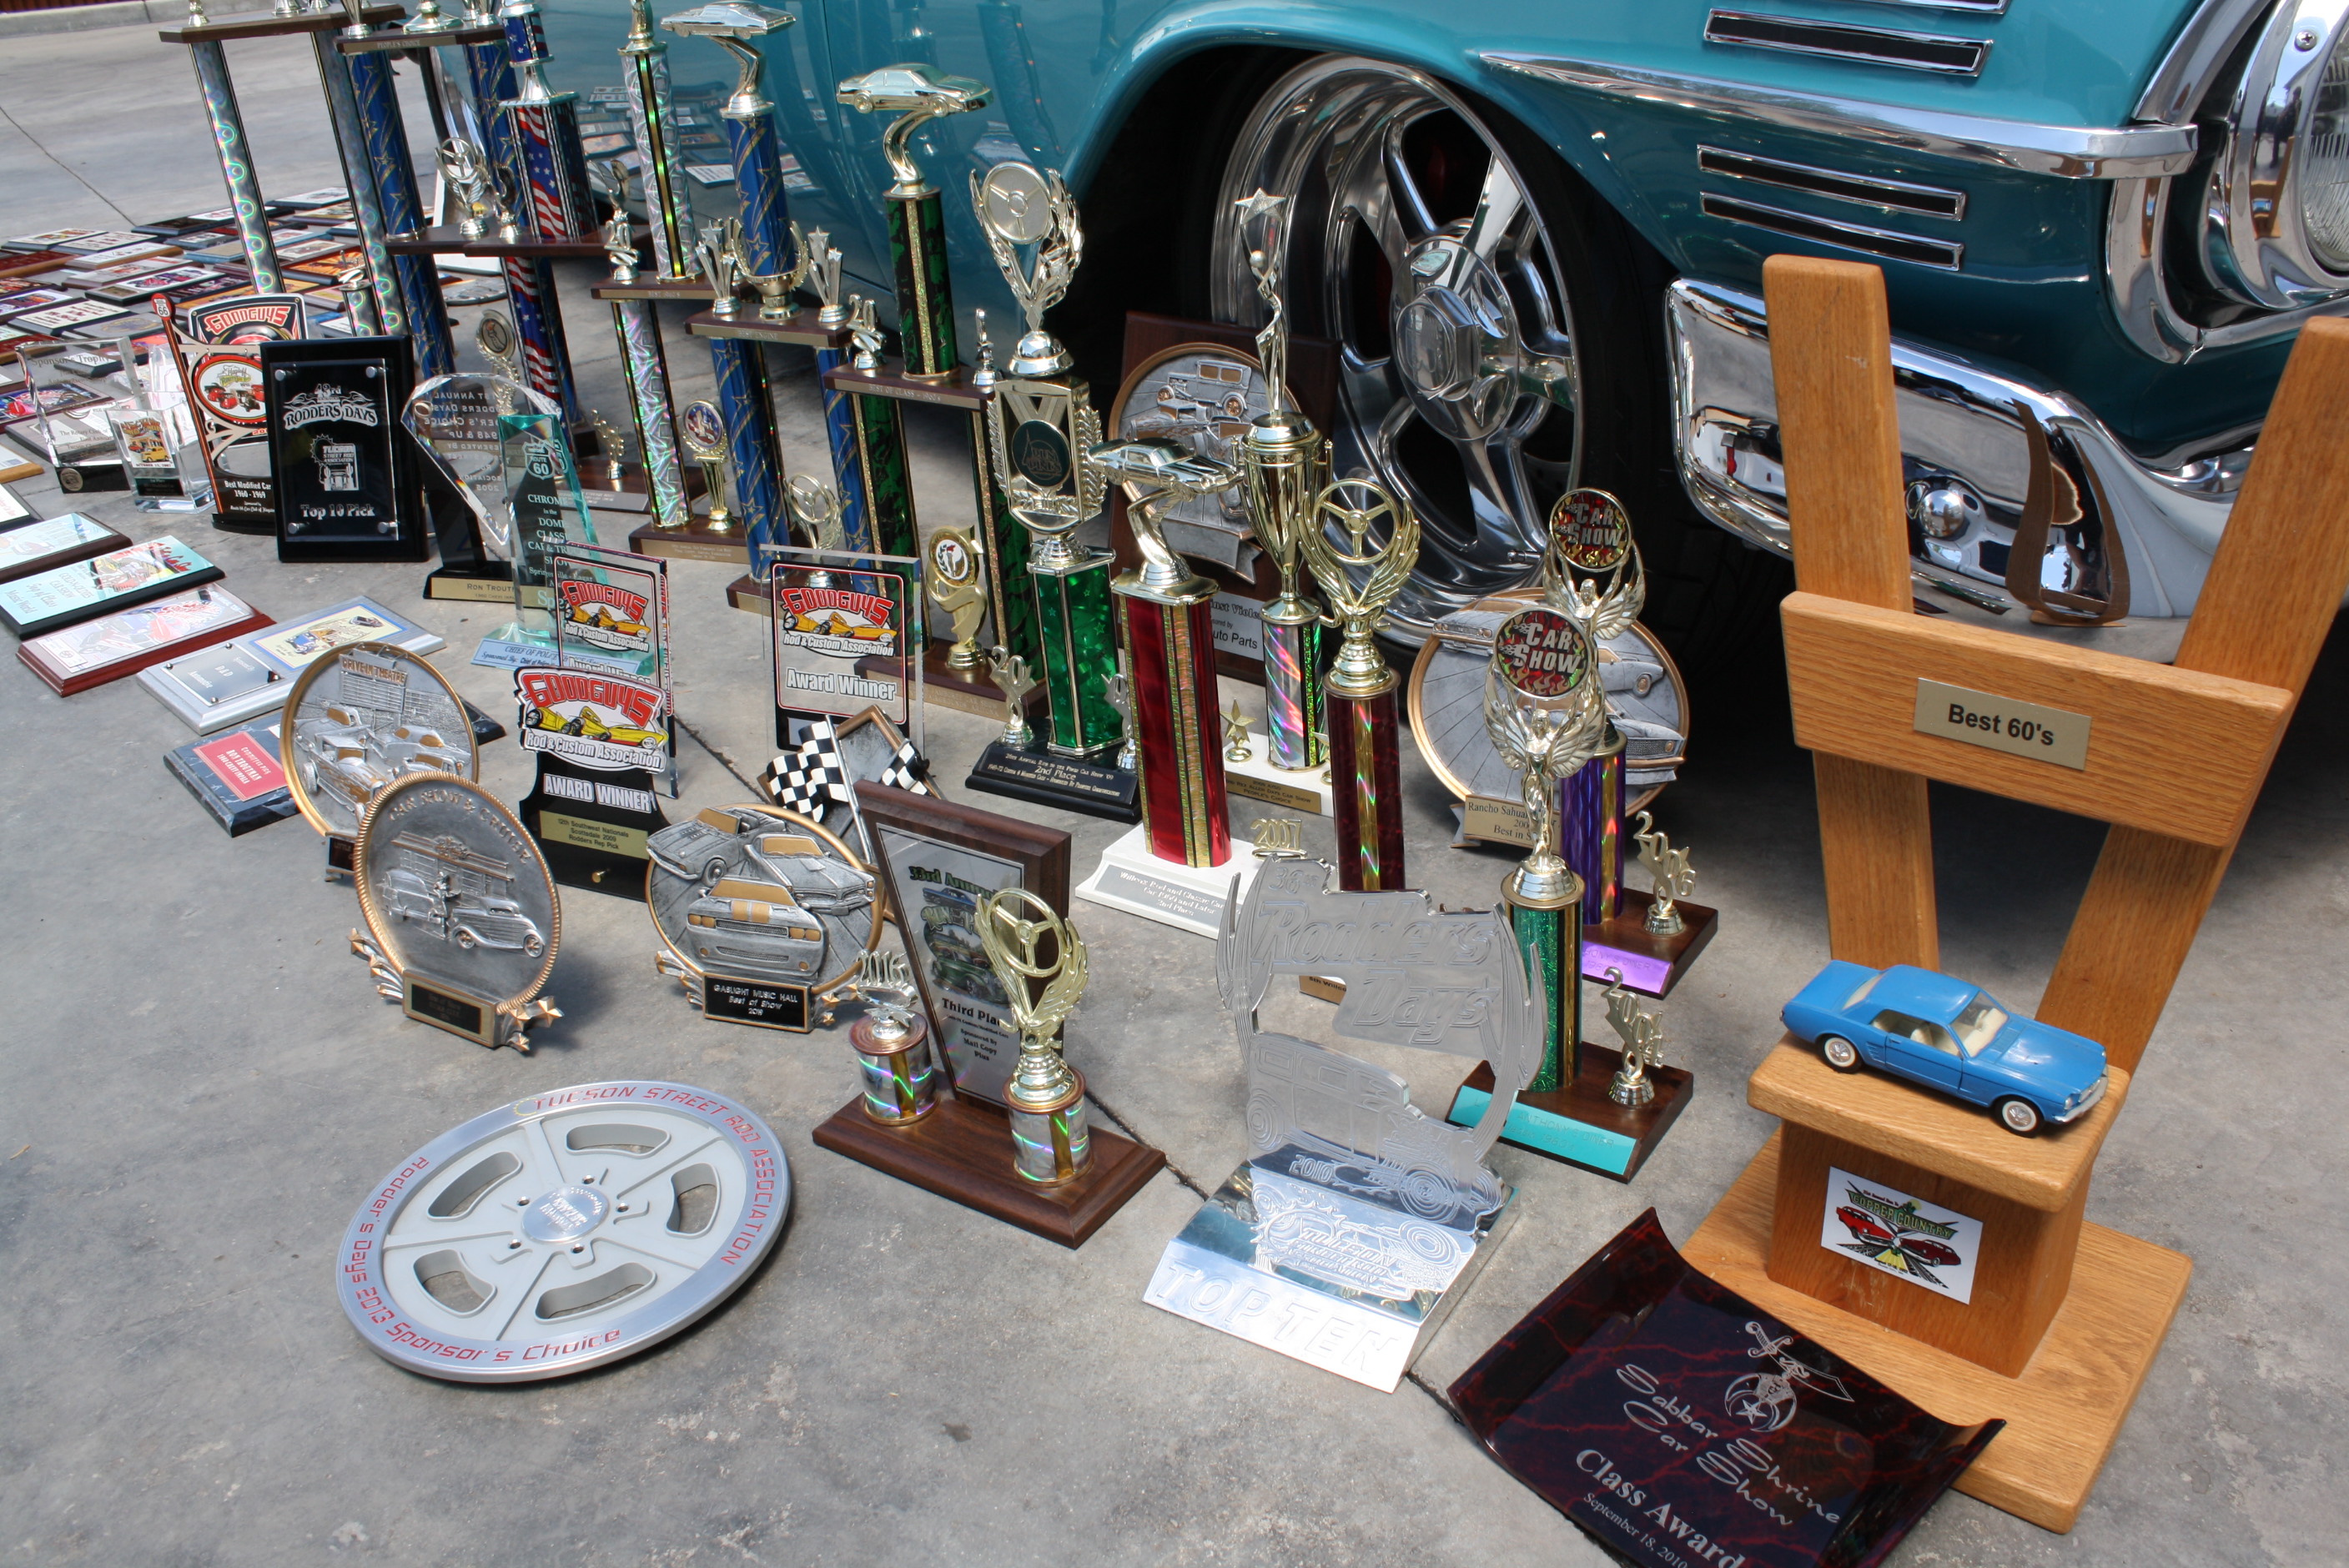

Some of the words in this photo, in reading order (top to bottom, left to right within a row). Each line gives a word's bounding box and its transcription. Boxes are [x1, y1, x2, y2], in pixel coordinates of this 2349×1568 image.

[204, 306, 291, 335] GOODGUYS
[314, 383, 342, 398] 43rd
[284, 404, 343, 430] RODDERS
[342, 405, 378, 426] DAYS
[533, 463, 549, 475] 60
[237, 480, 261, 489] Modified
[300, 504, 326, 520] Top
[329, 504, 345, 516] 10
[346, 504, 375, 517] Pick
[1576, 503, 1614, 527] CAR
[1567, 523, 1623, 547] SHOW
[467, 583, 483, 591] RON
[561, 580, 649, 624] GOODGUYS
[781, 588, 894, 627] GOODGUYS
[505, 645, 525, 655] CHIEF
[565, 625, 578, 635] Rod
[583, 629, 609, 644] Custom
[610, 634, 650, 652] Association
[783, 633, 801, 646] Rod
[807, 637, 841, 650] Custom
[842, 641, 894, 656] Association
[1212, 629, 1229, 642] uto
[1231, 633, 1258, 650] Parts
[1527, 622, 1572, 652] CAR
[1514, 642, 1581, 674] SHOW
[374, 666, 406, 683] THEATRE
[787, 668, 835, 693] Award
[838, 676, 897, 700] Winner
[522, 674, 659, 728] GOODGUYS
[1949, 703, 2000, 733] Best
[2008, 718, 2054, 746] 60's
[526, 732, 547, 750] Rod
[547, 739, 556, 750] &
[556, 736, 595, 758] Custom
[597, 745, 661, 768] Association
[1034, 766, 1051, 775] 2nd
[1054, 771, 1076, 781] Place
[390, 797, 415, 822] CAR
[421, 788, 464, 806] SHOW
[545, 774, 594, 802] AWARD
[596, 783, 651, 813] WINNER
[1468, 802, 1499, 815] Rancho
[569, 834, 593, 845] Rodders
[594, 839, 605, 848] Rep
[606, 841, 619, 850] Pick
[571, 820, 601, 832] Southwest
[602, 827, 629, 837] Nationals
[571, 827, 601, 839] Scottsdale
[1251, 820, 1302, 852] 2007
[1494, 824, 1512, 835] Best
[1515, 829, 1524, 839] in
[908, 866, 943, 884] 33rd
[1251, 899, 1501, 966] Rodders
[713, 984, 749, 997] GASLIGHT
[752, 988, 777, 999] MUSIC
[779, 992, 797, 1003] HALL
[728, 995, 746, 1004] Best
[749, 999, 758, 1008] of
[761, 1000, 782, 1009] Show
[1352, 968, 1501, 1045] Days
[942, 998, 973, 1017] Third
[978, 1009, 999, 1027] Pla
[960, 1028, 988, 1043] Sponsored
[980, 1043, 997, 1055] Copy
[974, 1050, 989, 1061] Plus
[534, 1085, 638, 1111] TUCSON
[642, 1086, 729, 1116] STREET
[722, 1114, 762, 1144] ROD
[1289, 1154, 1335, 1182] 2010
[361, 1156, 430, 1234] Rodder's
[720, 1148, 776, 1267] ASSOCIATION
[1853, 1194, 1894, 1222] COPPER
[1897, 1212, 1950, 1239] COUNTRY
[344, 1239, 372, 1284] Days
[355, 1286, 396, 1325] 2013
[1156, 1262, 1272, 1324] TOP
[1275, 1303, 1399, 1374] TEN
[385, 1321, 515, 1363] Sponsor's
[522, 1328, 621, 1361] Choice
[1617, 1363, 1718, 1440] Sabbar
[1727, 1437, 1843, 1525] Shrine
[1623, 1400, 1689, 1453] Car
[1696, 1451, 1794, 1526] Show
[1576, 1449, 1648, 1508] Class
[1643, 1502, 1747, 1568] Award
[1584, 1491, 1640, 1538] September
[1640, 1533, 1657, 1559] 18,
[1657, 1537, 1688, 1568] 2010
